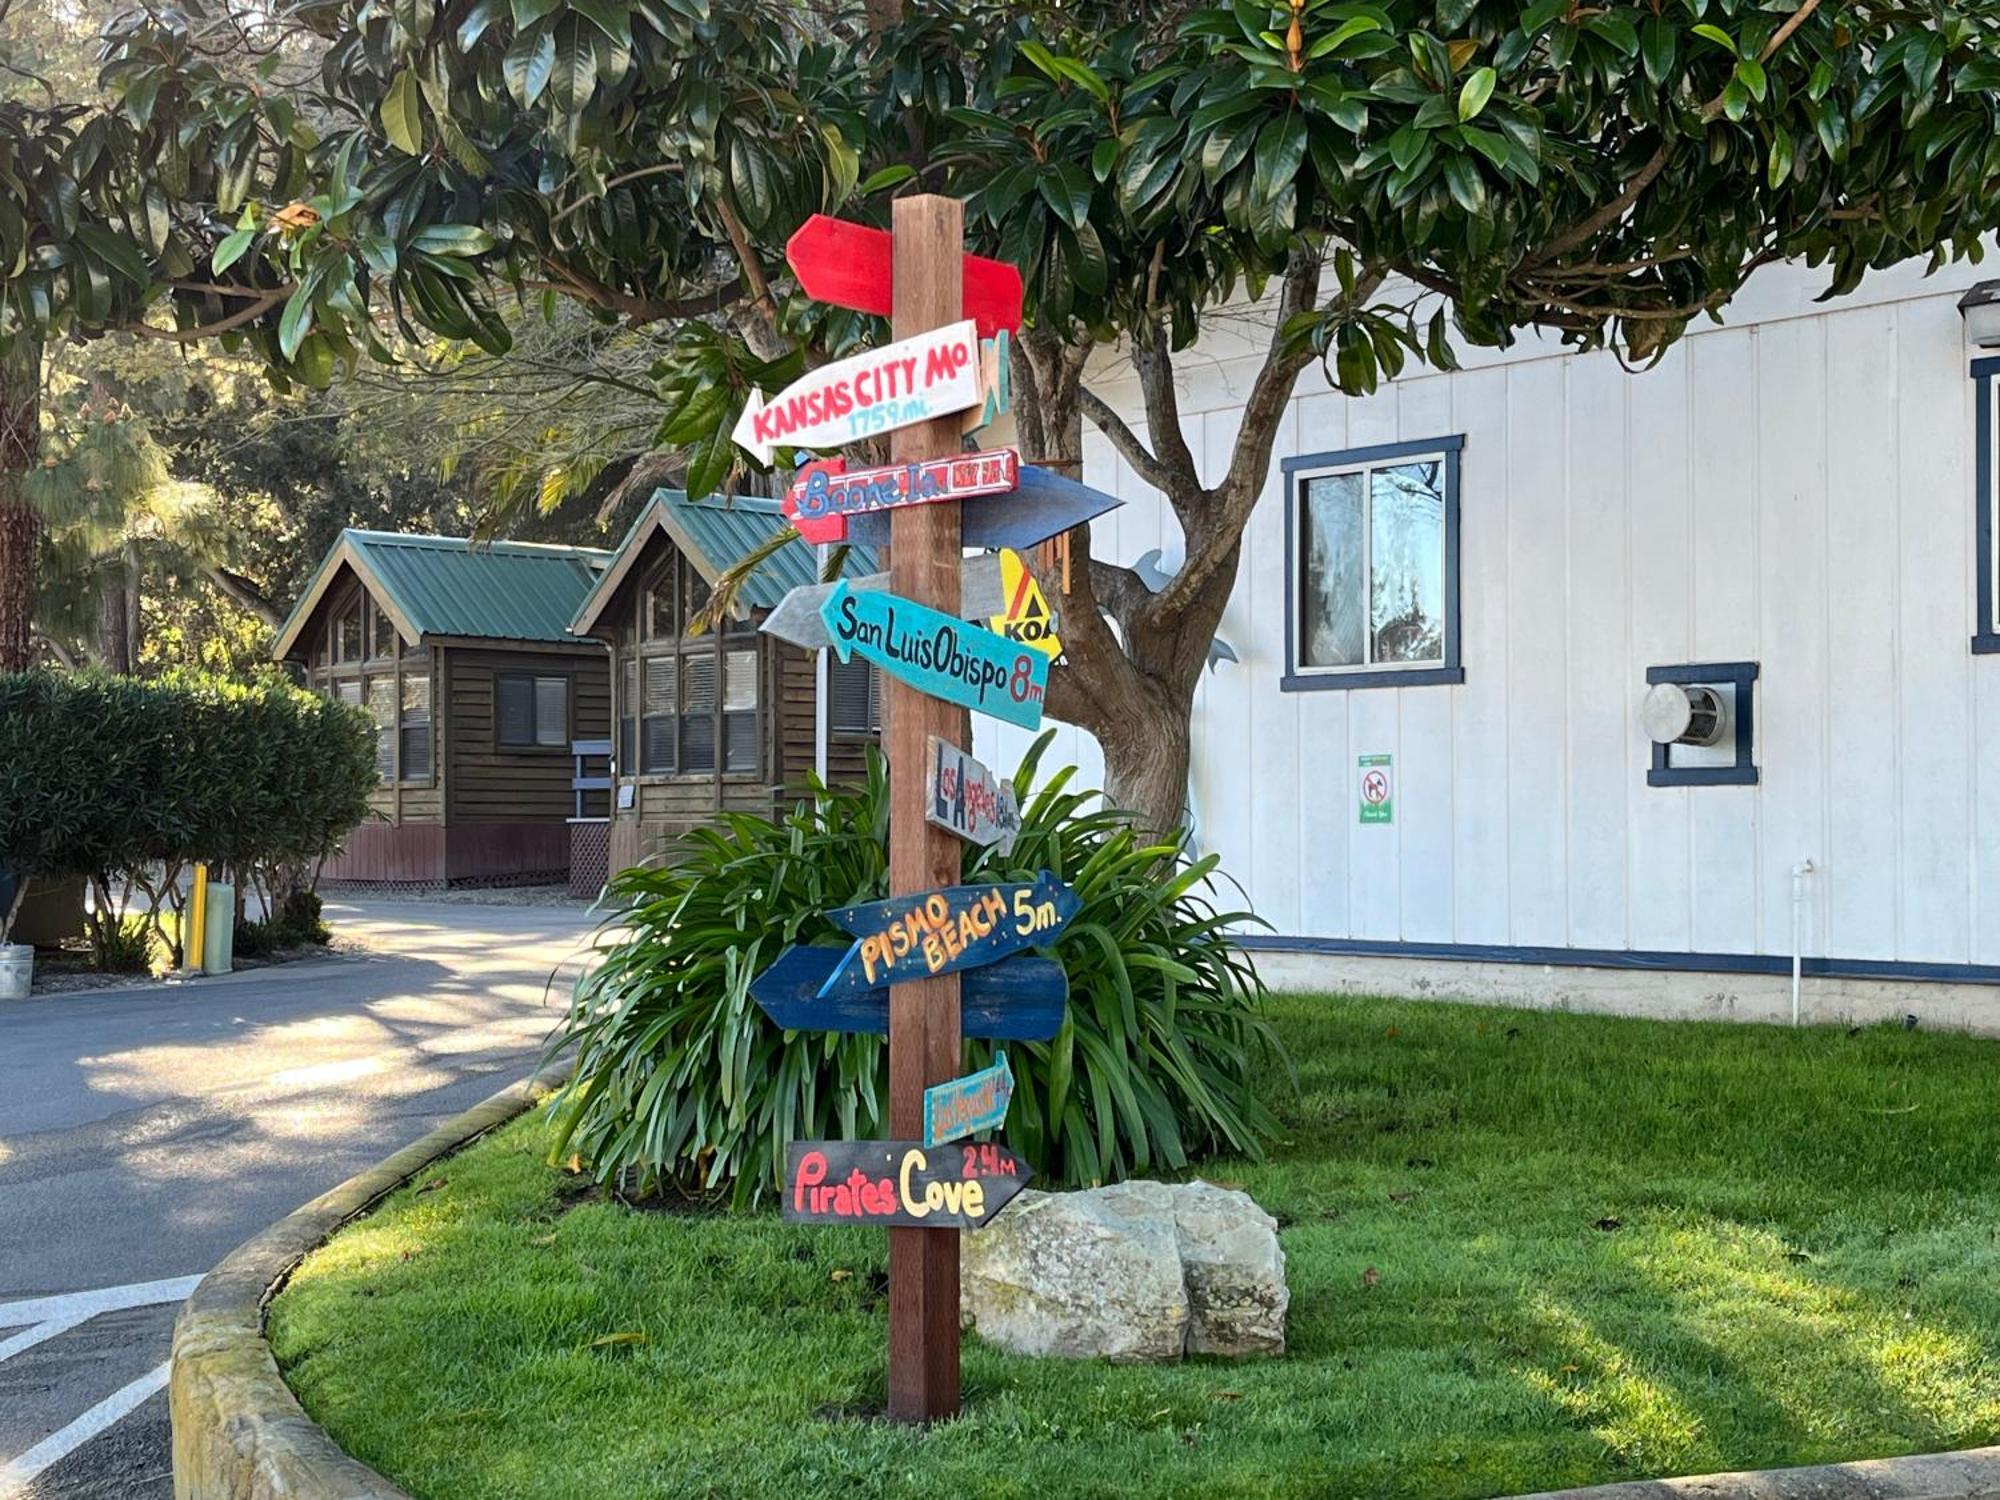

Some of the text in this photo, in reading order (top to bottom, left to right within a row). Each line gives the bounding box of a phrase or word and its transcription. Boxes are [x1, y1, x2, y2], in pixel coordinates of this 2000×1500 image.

[753, 381, 851, 444] KANSAS
[854, 357, 917, 407] CITY
[796, 470, 903, 519] Boone
[836, 595, 884, 650] San
[886, 607, 930, 670] Luis
[933, 625, 1008, 705] Obispo
[859, 894, 949, 985] PISMO
[922, 887, 1007, 973] BEACH
[794, 1151, 898, 1217] Pirates
[900, 1148, 985, 1218] Cove
